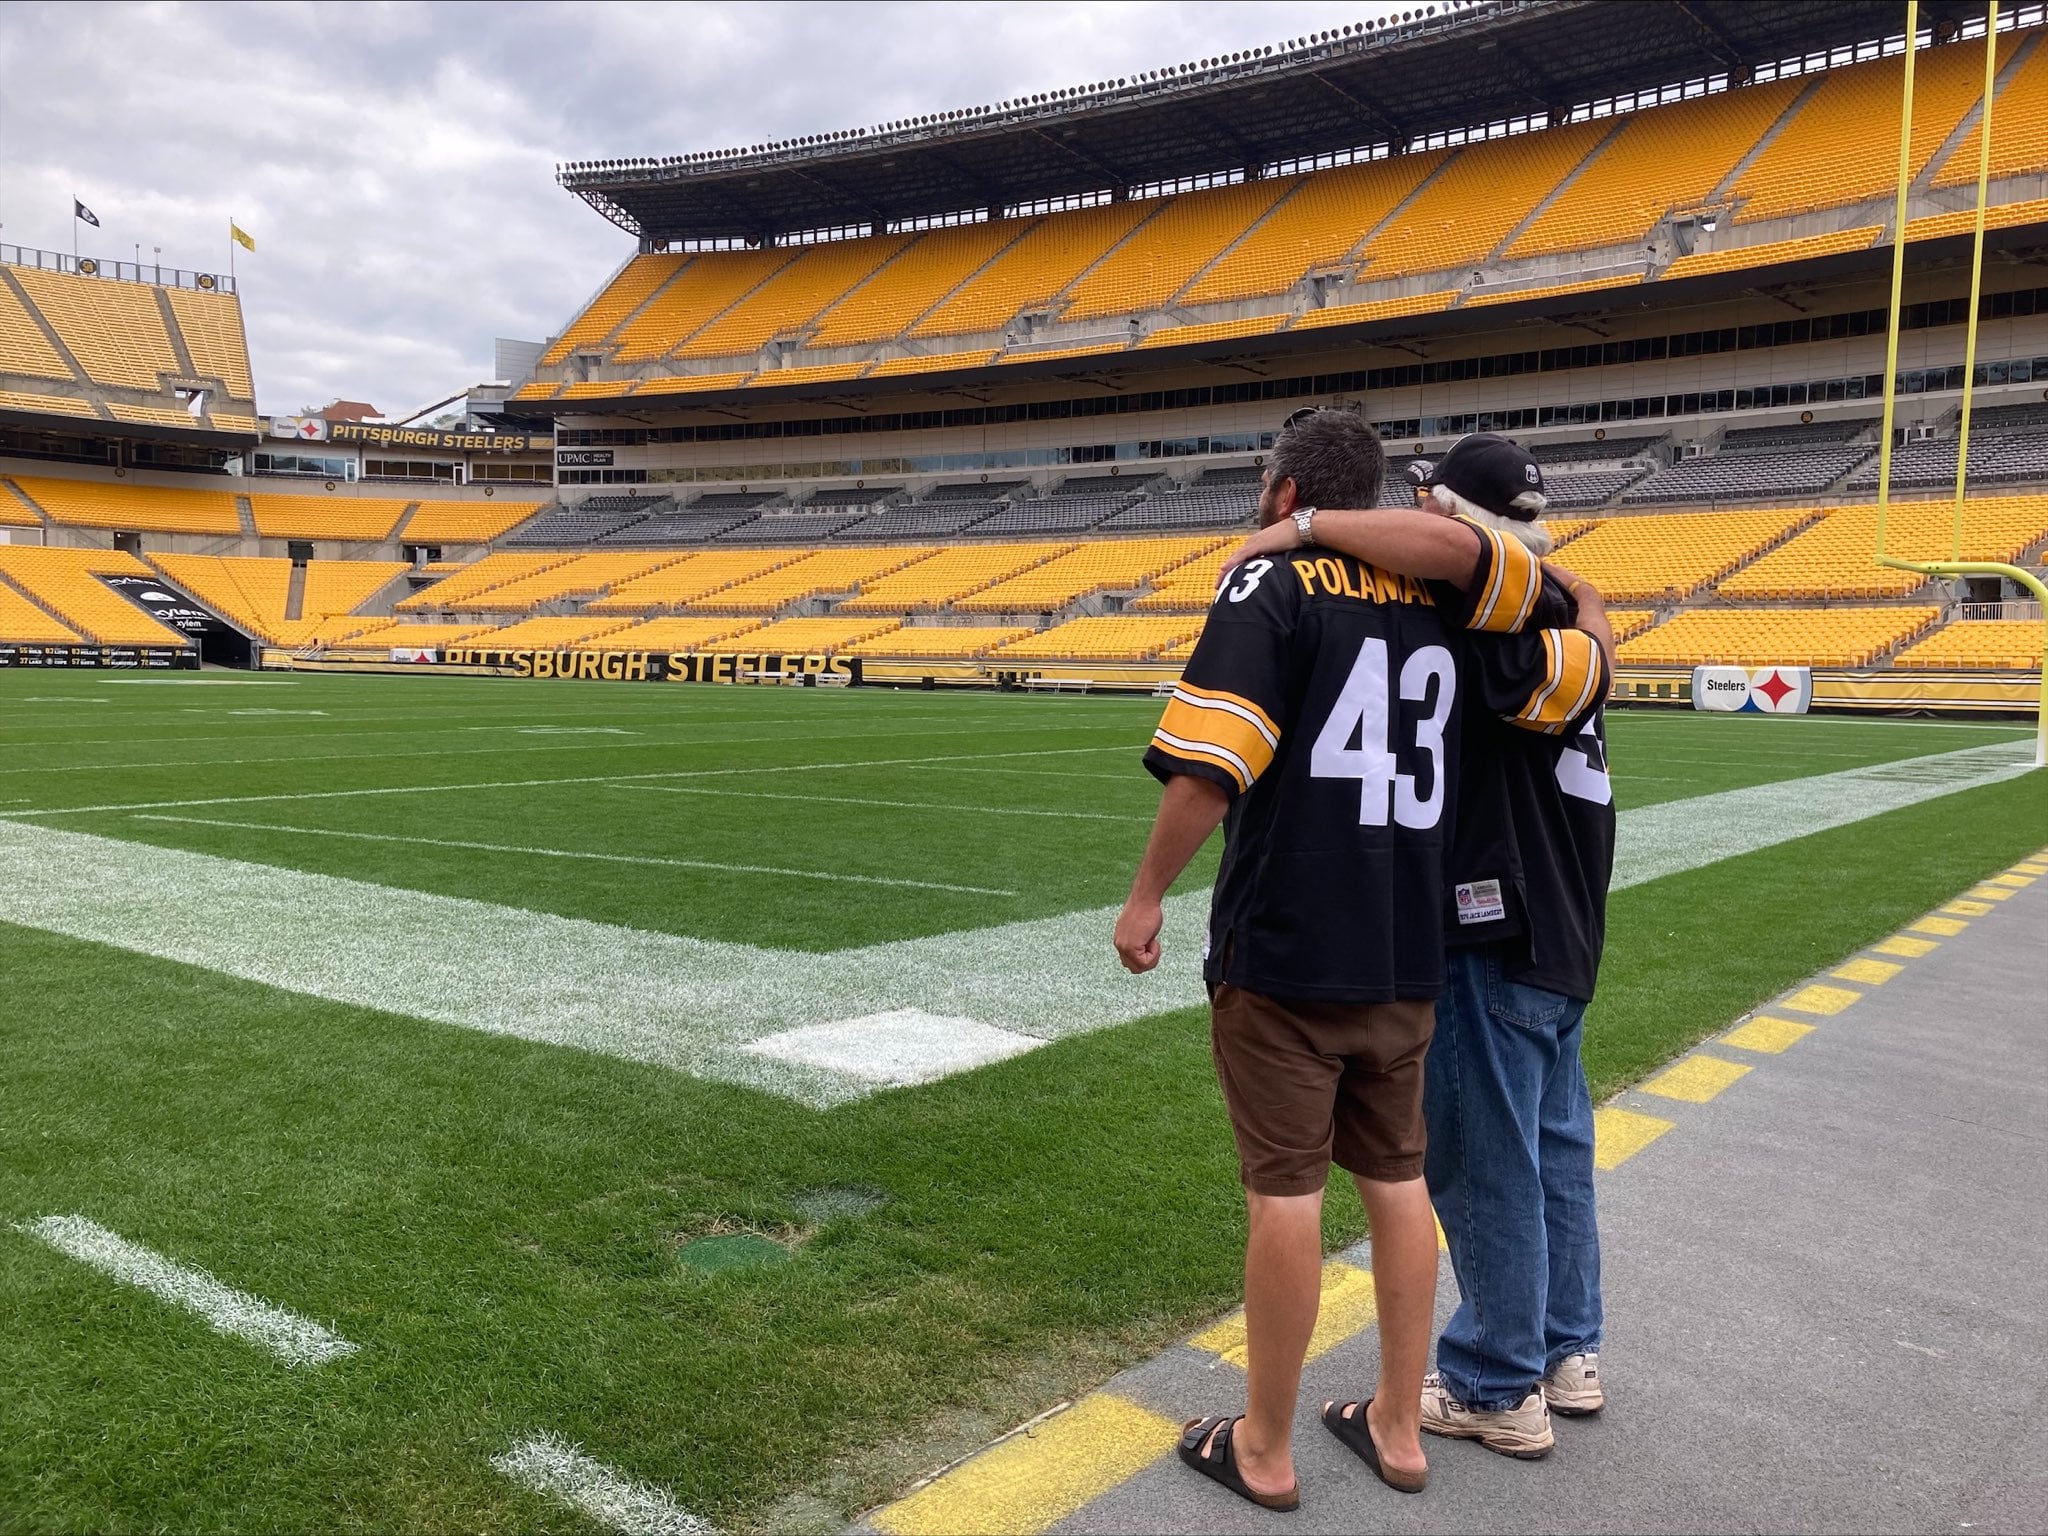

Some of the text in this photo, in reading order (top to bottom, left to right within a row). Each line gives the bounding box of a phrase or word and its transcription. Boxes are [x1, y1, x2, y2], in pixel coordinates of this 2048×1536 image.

[332, 424, 525, 449] PITTSBURGH STEELERS
[558, 453, 591, 464] UPMC
[1291, 558, 1436, 607] POLAMA
[176, 619, 202, 629] xylem
[1707, 679, 1746, 692] Steelers
[1310, 637, 1457, 830] 43
